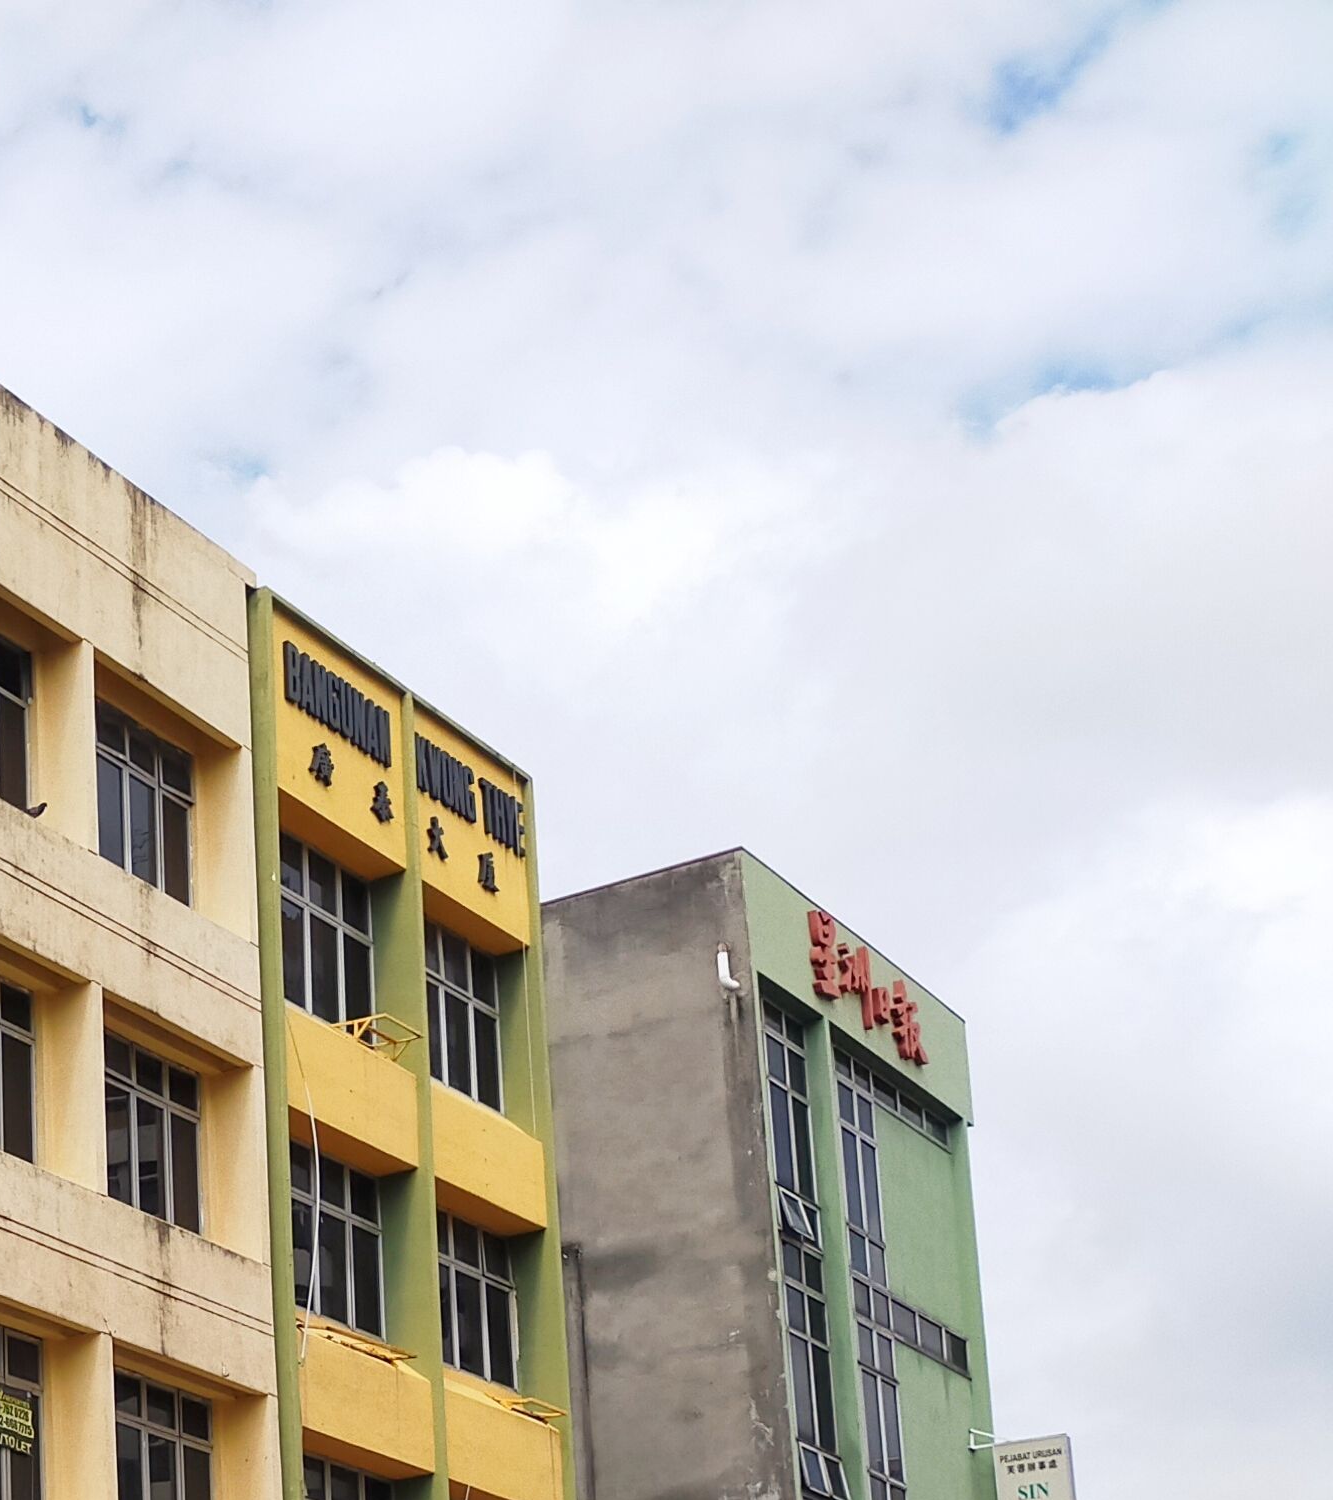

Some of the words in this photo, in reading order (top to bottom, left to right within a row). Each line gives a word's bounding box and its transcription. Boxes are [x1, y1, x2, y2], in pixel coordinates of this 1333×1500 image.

[282, 640, 392, 769] BANGUNAN
[414, 731, 477, 825] KWONG
[478, 777, 526, 859] THYE
